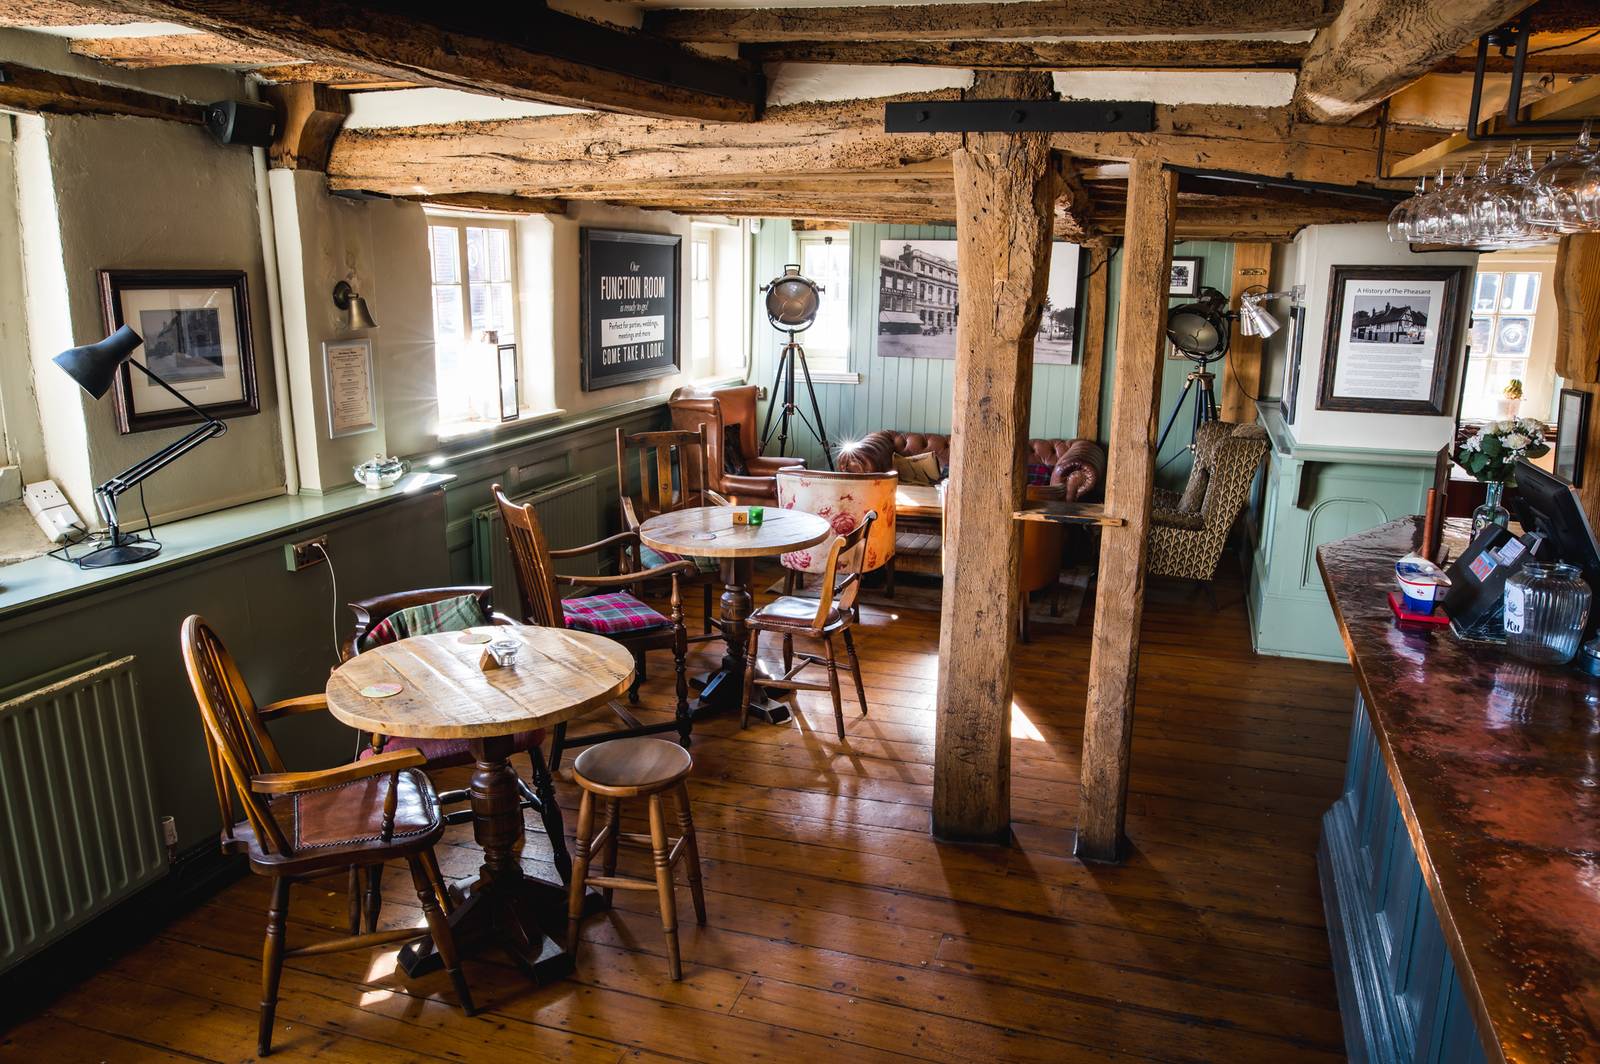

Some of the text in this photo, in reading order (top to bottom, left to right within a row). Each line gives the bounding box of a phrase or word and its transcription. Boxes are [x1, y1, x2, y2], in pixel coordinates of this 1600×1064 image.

[630, 261, 640, 272] Our
[601, 276, 665, 300] FUNCTION ROOM
[608, 322, 623, 331] Perfect
[618, 332, 635, 342] meetings
[602, 342, 664, 366] COME TAKE A LOOK!
